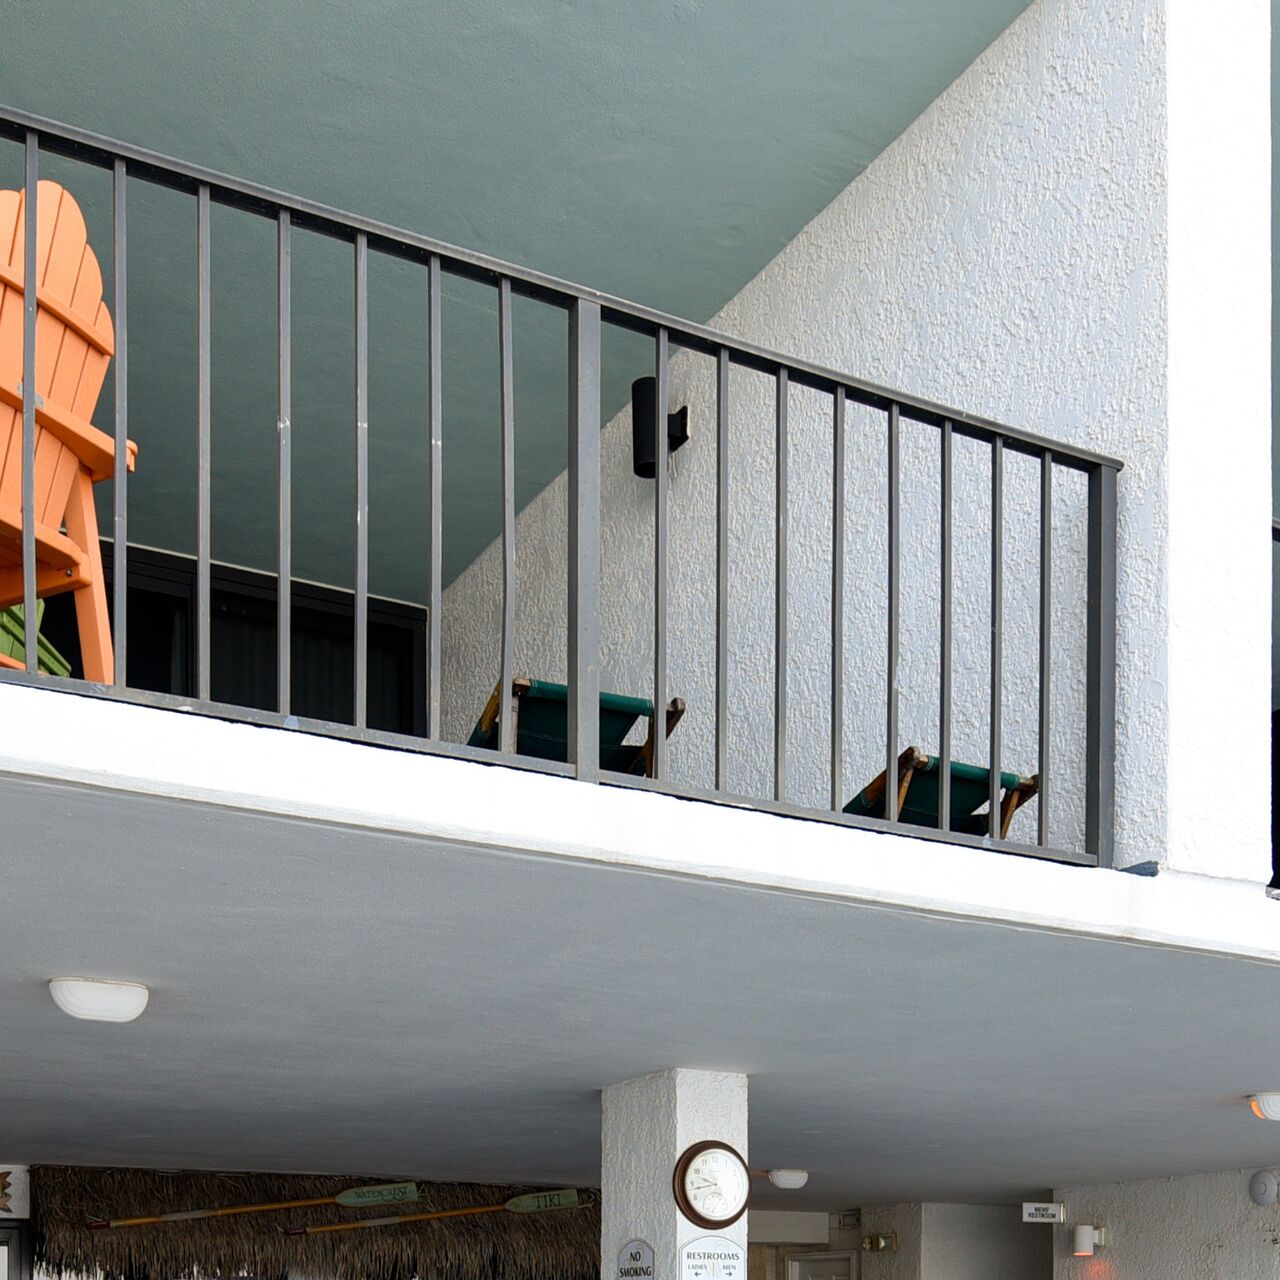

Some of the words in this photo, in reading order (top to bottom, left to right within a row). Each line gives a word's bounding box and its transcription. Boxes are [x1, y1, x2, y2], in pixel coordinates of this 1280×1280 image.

[354, 1186, 409, 1202] WATERCREST
[533, 1193, 561, 1209] TIKI
[629, 1250, 642, 1262] NO
[686, 1251, 740, 1261] RESTROOMS
[619, 1265, 652, 1278] SMOKING
